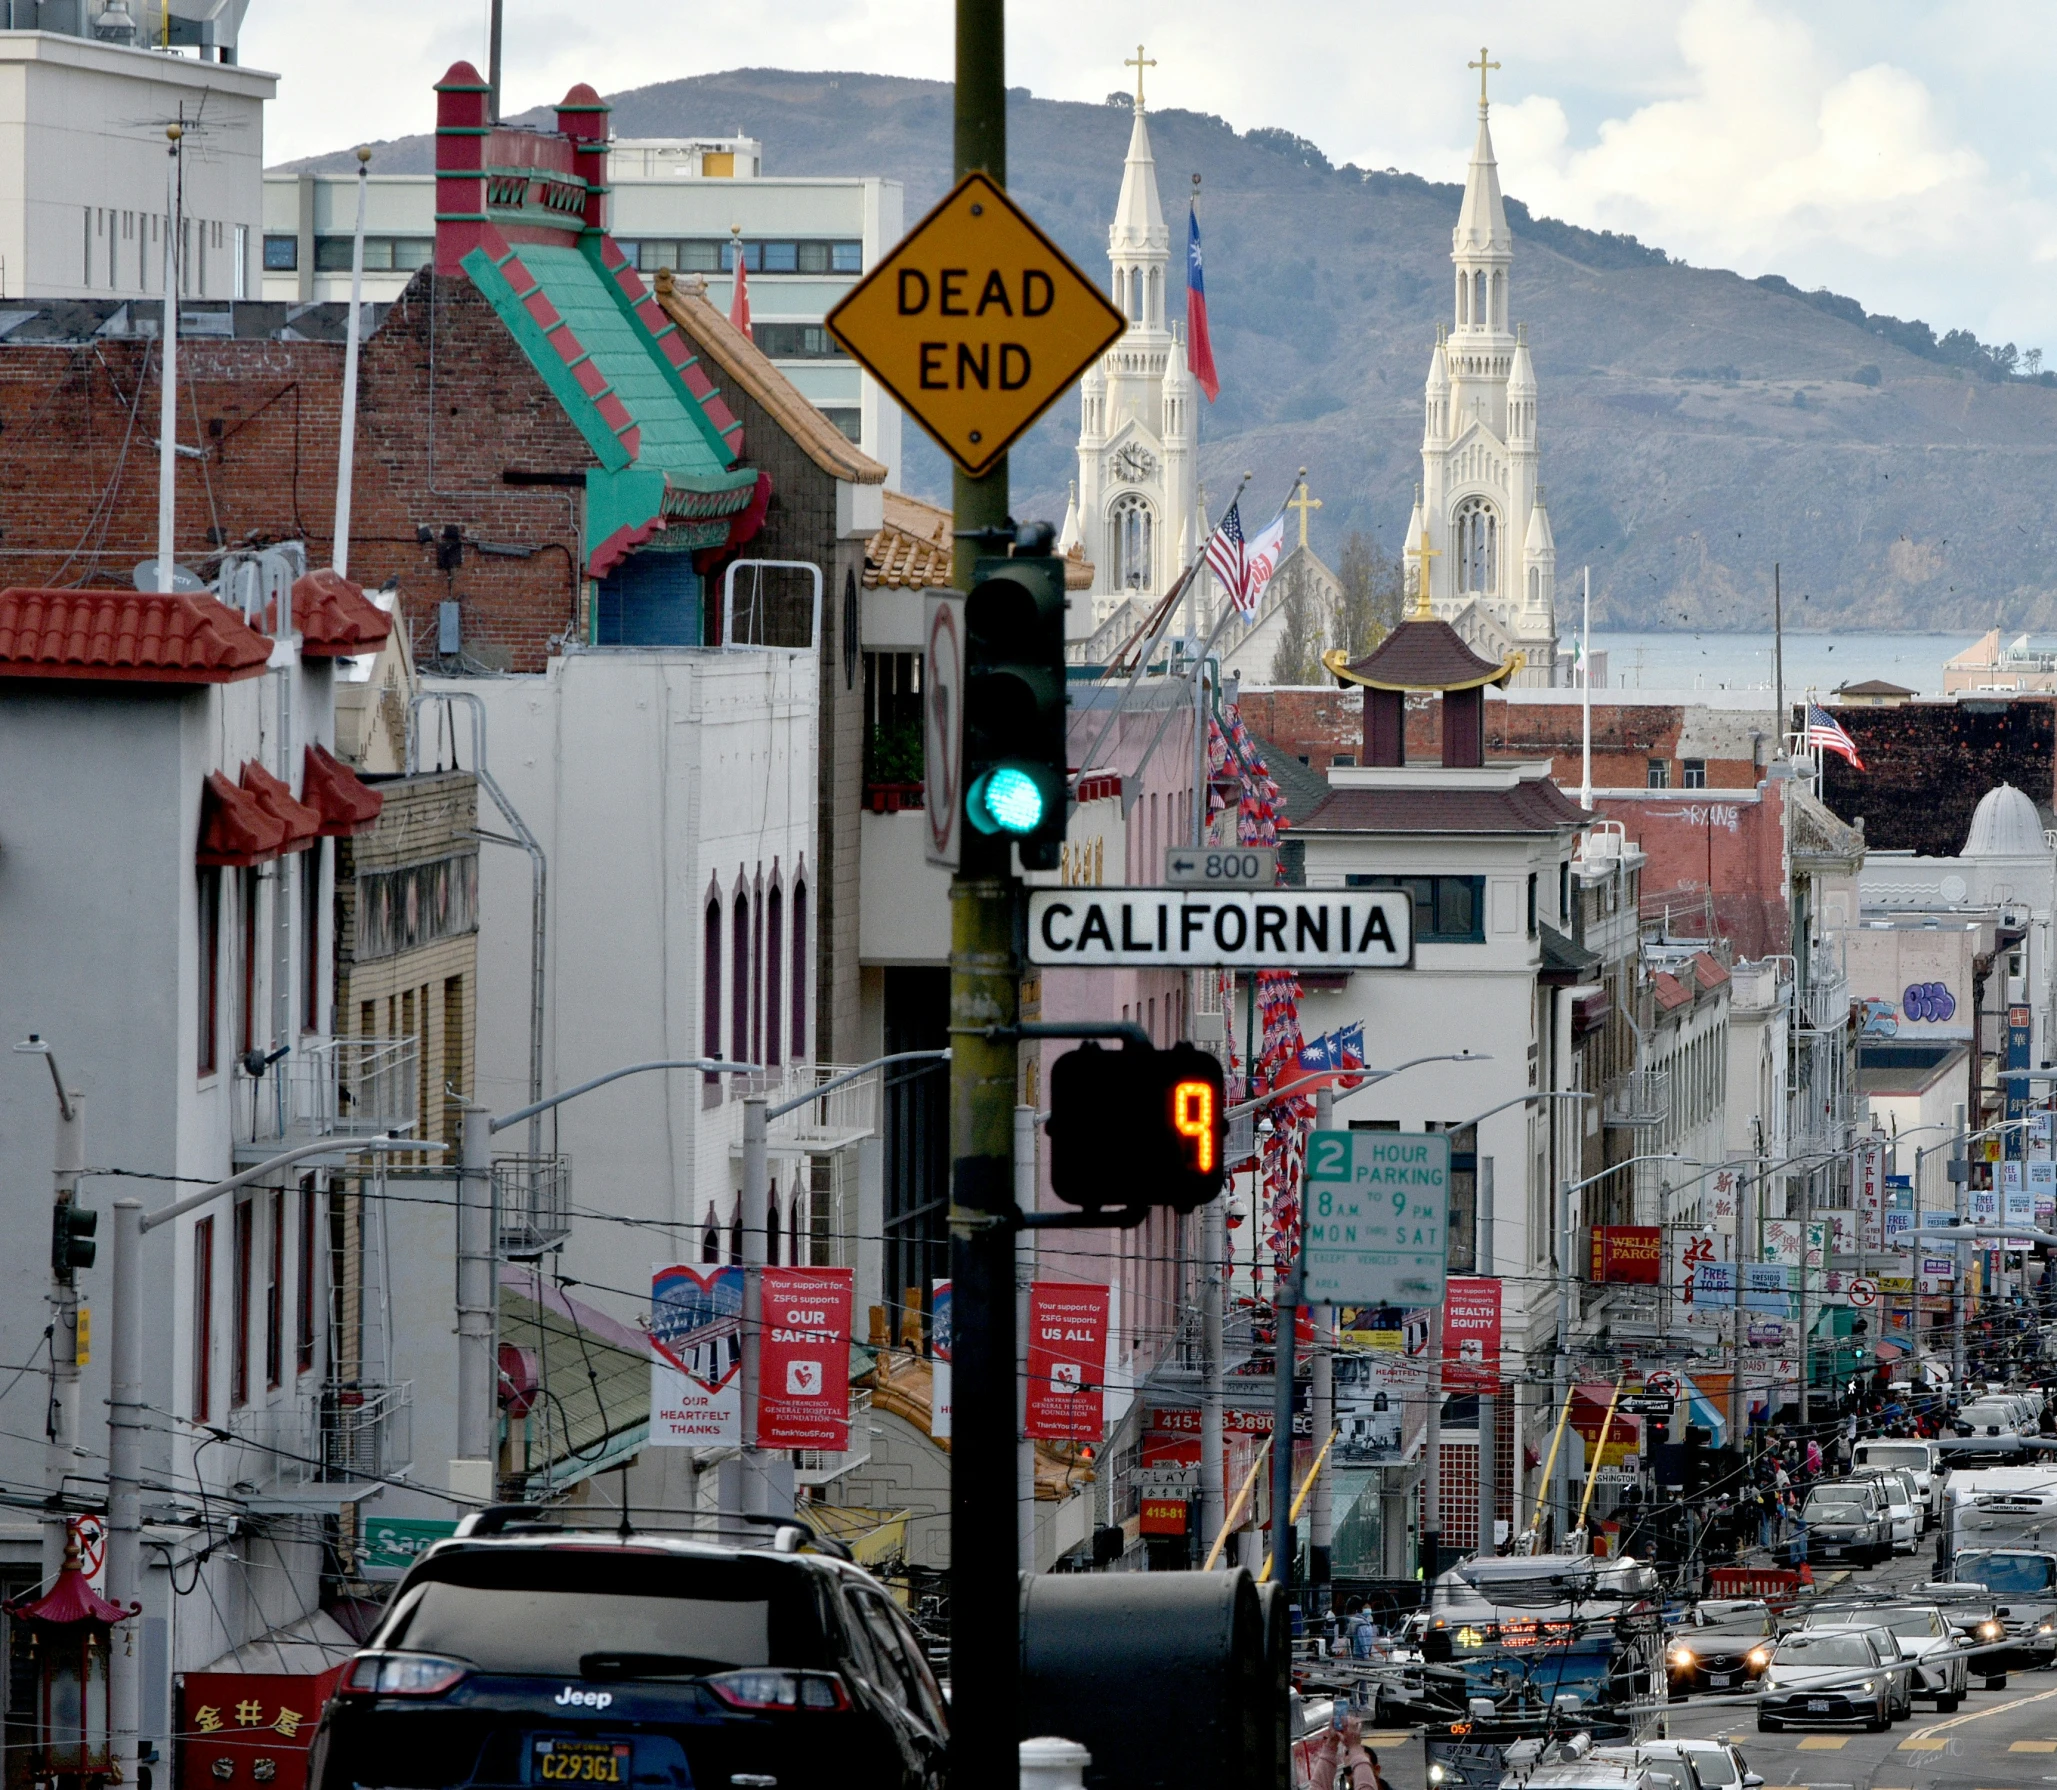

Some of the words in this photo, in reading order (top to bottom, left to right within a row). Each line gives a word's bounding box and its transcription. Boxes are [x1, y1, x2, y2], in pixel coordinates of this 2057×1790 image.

[897, 269, 1055, 317] DEAD
[919, 342, 1032, 390] END
[1204, 853, 1259, 880] 800
[1041, 903, 1397, 953] CALIFORNIA
[2010, 1032, 2026, 1146] 華銀行
[1173, 1081, 1213, 1172] 9
[1316, 1139, 1345, 1175] 2
[1373, 1145, 1427, 1163] HOUR
[2005, 1165, 2016, 1174] REE
[1356, 1166, 1443, 1186] PARKING
[1318, 1191, 1332, 1217] 8
[1367, 1192, 1382, 1201] TO
[1392, 1191, 1406, 1218] 9
[1976, 1195, 1993, 1203] FREE
[1974, 1204, 1983, 1212] TO
[1985, 1204, 1995, 1213] BE
[1888, 1214, 1908, 1225] FREE
[1312, 1224, 1356, 1243] MON
[1396, 1226, 1437, 1245] SAT
[1886, 1224, 1896, 1235] TO
[1611, 1236, 1660, 1248] WELLS
[1314, 1253, 1347, 1264] EXCEPT
[1358, 1255, 1398, 1266] VEHICLES
[1611, 1248, 1660, 1260] FARGO
[1702, 1268, 1728, 1280] FREE
[770, 1280, 791, 1289] Your
[792, 1280, 828, 1292] support
[829, 1281, 843, 1290] for
[1315, 1279, 1340, 1289] AREA
[1700, 1280, 1713, 1292] TO
[1716, 1281, 1729, 1292] BE
[773, 1294, 798, 1303] ZSFG
[799, 1295, 840, 1305] supports
[1038, 1302, 1056, 1310] Your
[1057, 1302, 1088, 1313] support
[1088, 1303, 1101, 1312] for
[1450, 1307, 1495, 1317] HEALTH
[786, 1310, 825, 1325] OUR
[1040, 1314, 1061, 1323] ZSFG
[1063, 1315, 1097, 1324] supports
[1450, 1319, 1494, 1329] EQUITY
[771, 1329, 841, 1344] SAFETY
[1041, 1328, 1062, 1340] US
[1064, 1329, 1095, 1342] ALL
[1743, 1360, 1767, 1371] DAISY
[1376, 1369, 1421, 1377] HEARTFELT
[682, 1396, 708, 1406] OUR
[1031, 1402, 1063, 1410] GENERAL
[660, 1410, 731, 1421] HEARTFELT
[802, 1407, 842, 1415] HOSPITAL
[775, 1414, 831, 1422] FOUNDATION
[669, 1424, 722, 1435] THANKS
[771, 1428, 835, 1440] ThankYouSF.org
[1146, 1507, 1186, 1519] 415-81
[554, 1685, 613, 1710] Jeep
[194, 1699, 304, 1738] 金井屋
